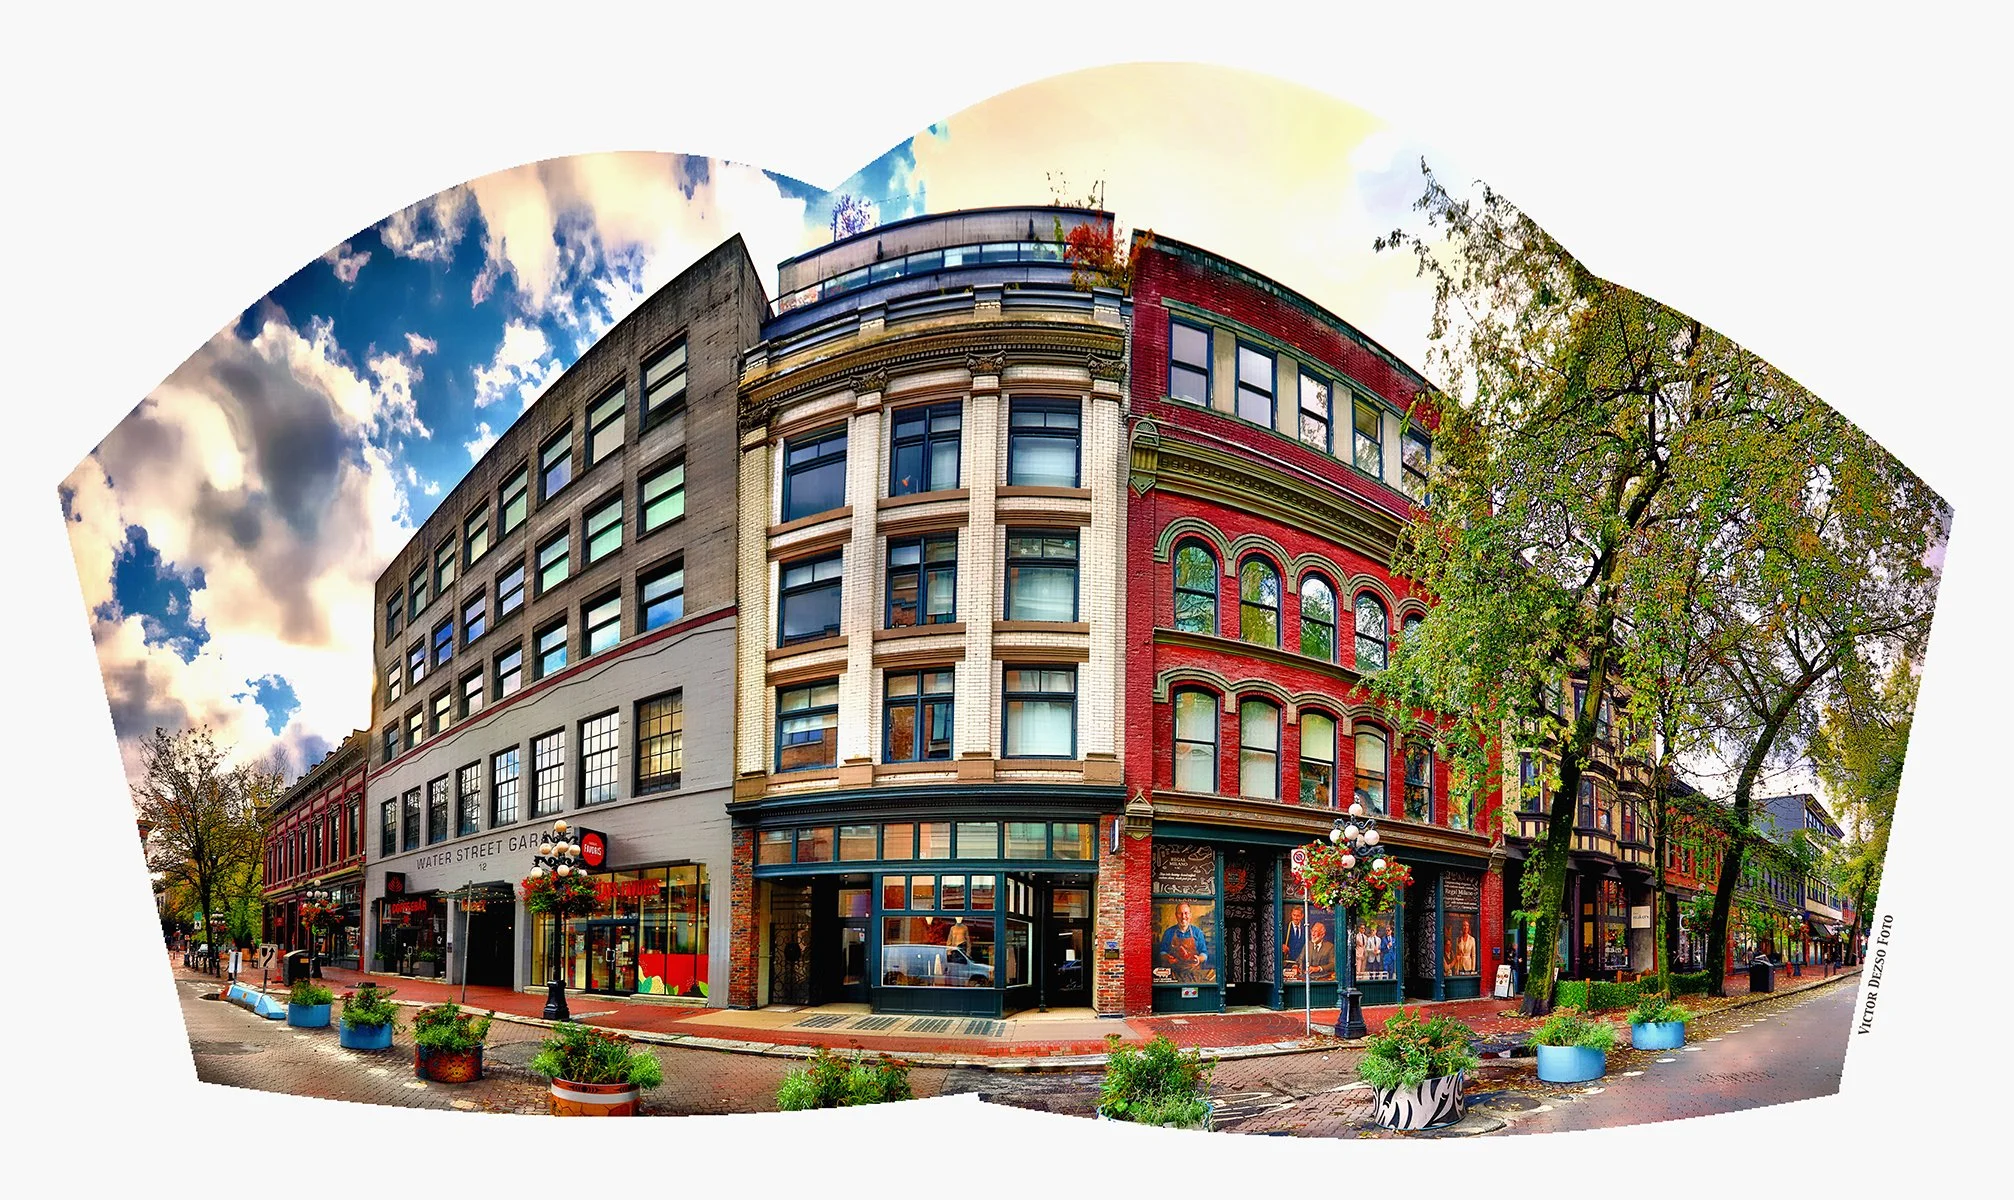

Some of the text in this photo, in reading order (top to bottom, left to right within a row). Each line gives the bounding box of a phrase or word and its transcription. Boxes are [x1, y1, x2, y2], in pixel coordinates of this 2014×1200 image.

[416, 852, 452, 870] WATER
[456, 839, 503, 862] STREET
[478, 862, 487, 872] 12
